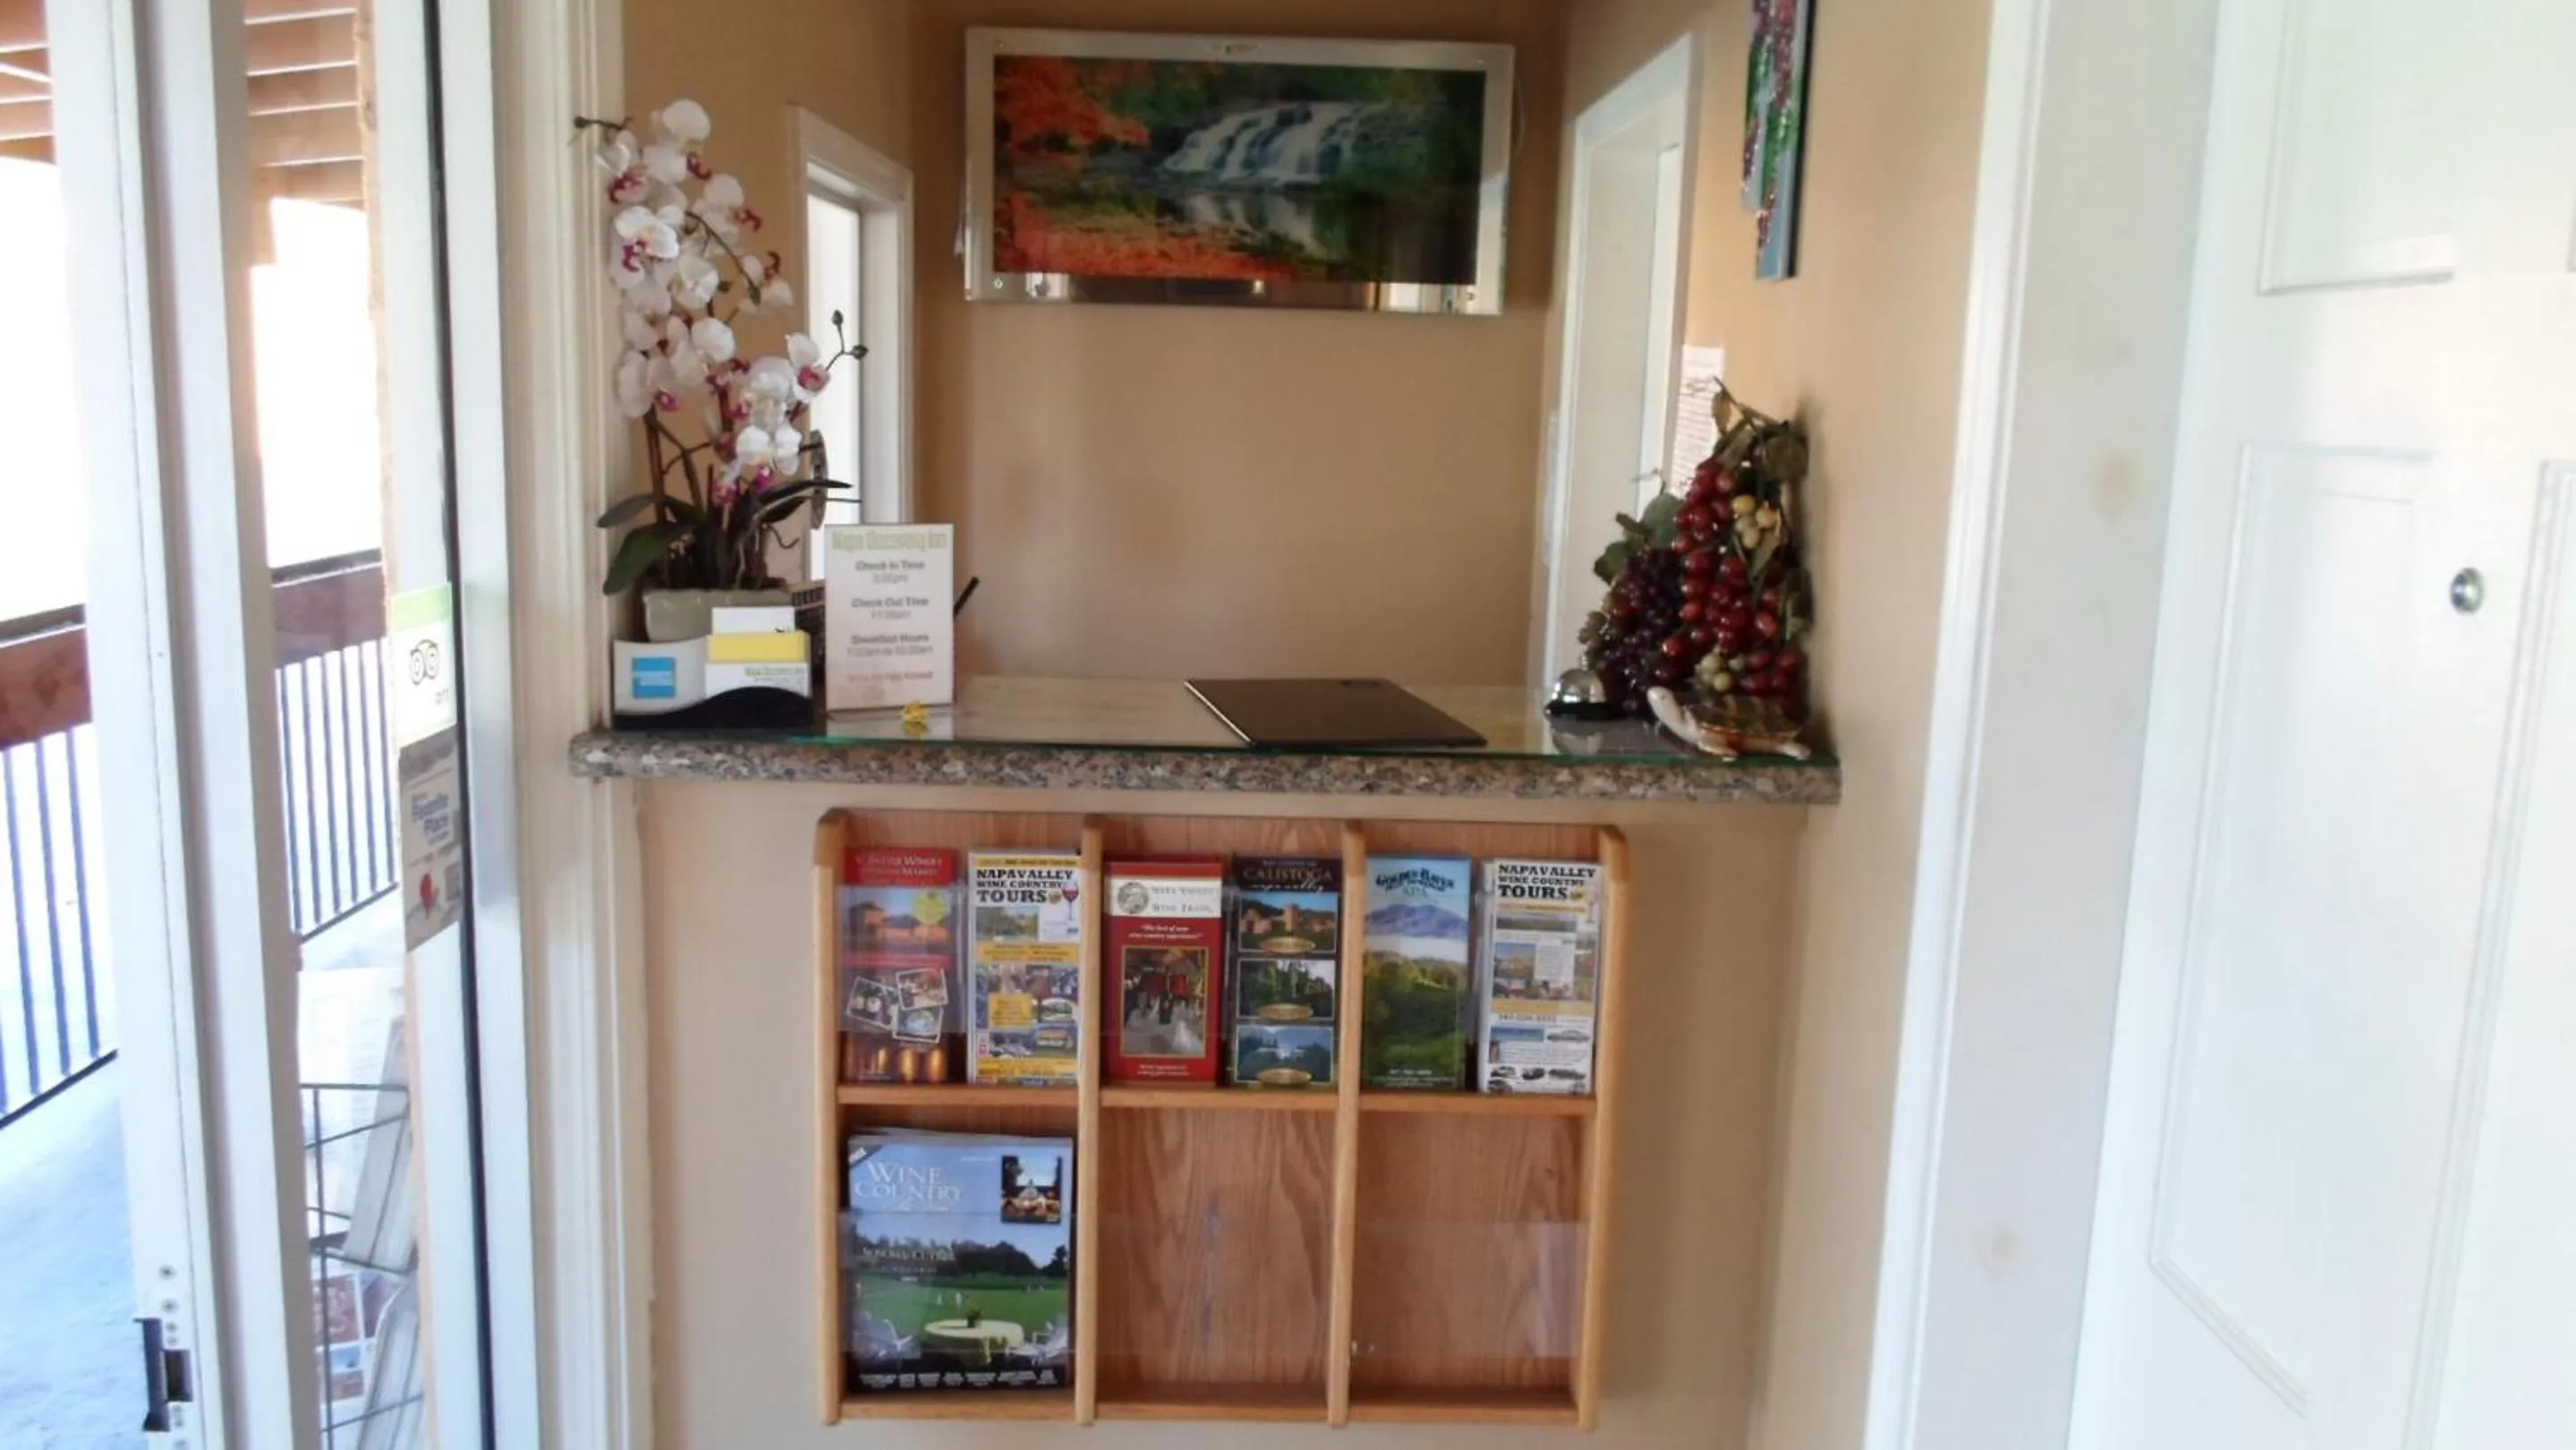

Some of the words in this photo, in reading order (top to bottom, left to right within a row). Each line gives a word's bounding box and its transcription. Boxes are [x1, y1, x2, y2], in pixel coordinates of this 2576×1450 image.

[855, 559, 887, 571] Check
[900, 559, 927, 571] Time
[905, 596, 930, 607] Time
[1242, 866, 1333, 883] CALISTOGA
[1497, 876, 1528, 884] WINE
[976, 880, 1007, 888] WINE
[976, 889, 1047, 903] TOURS
[1497, 884, 1568, 900] TOURS
[867, 1162, 943, 1185] WINE
[854, 1181, 963, 1203] COUNTRY
